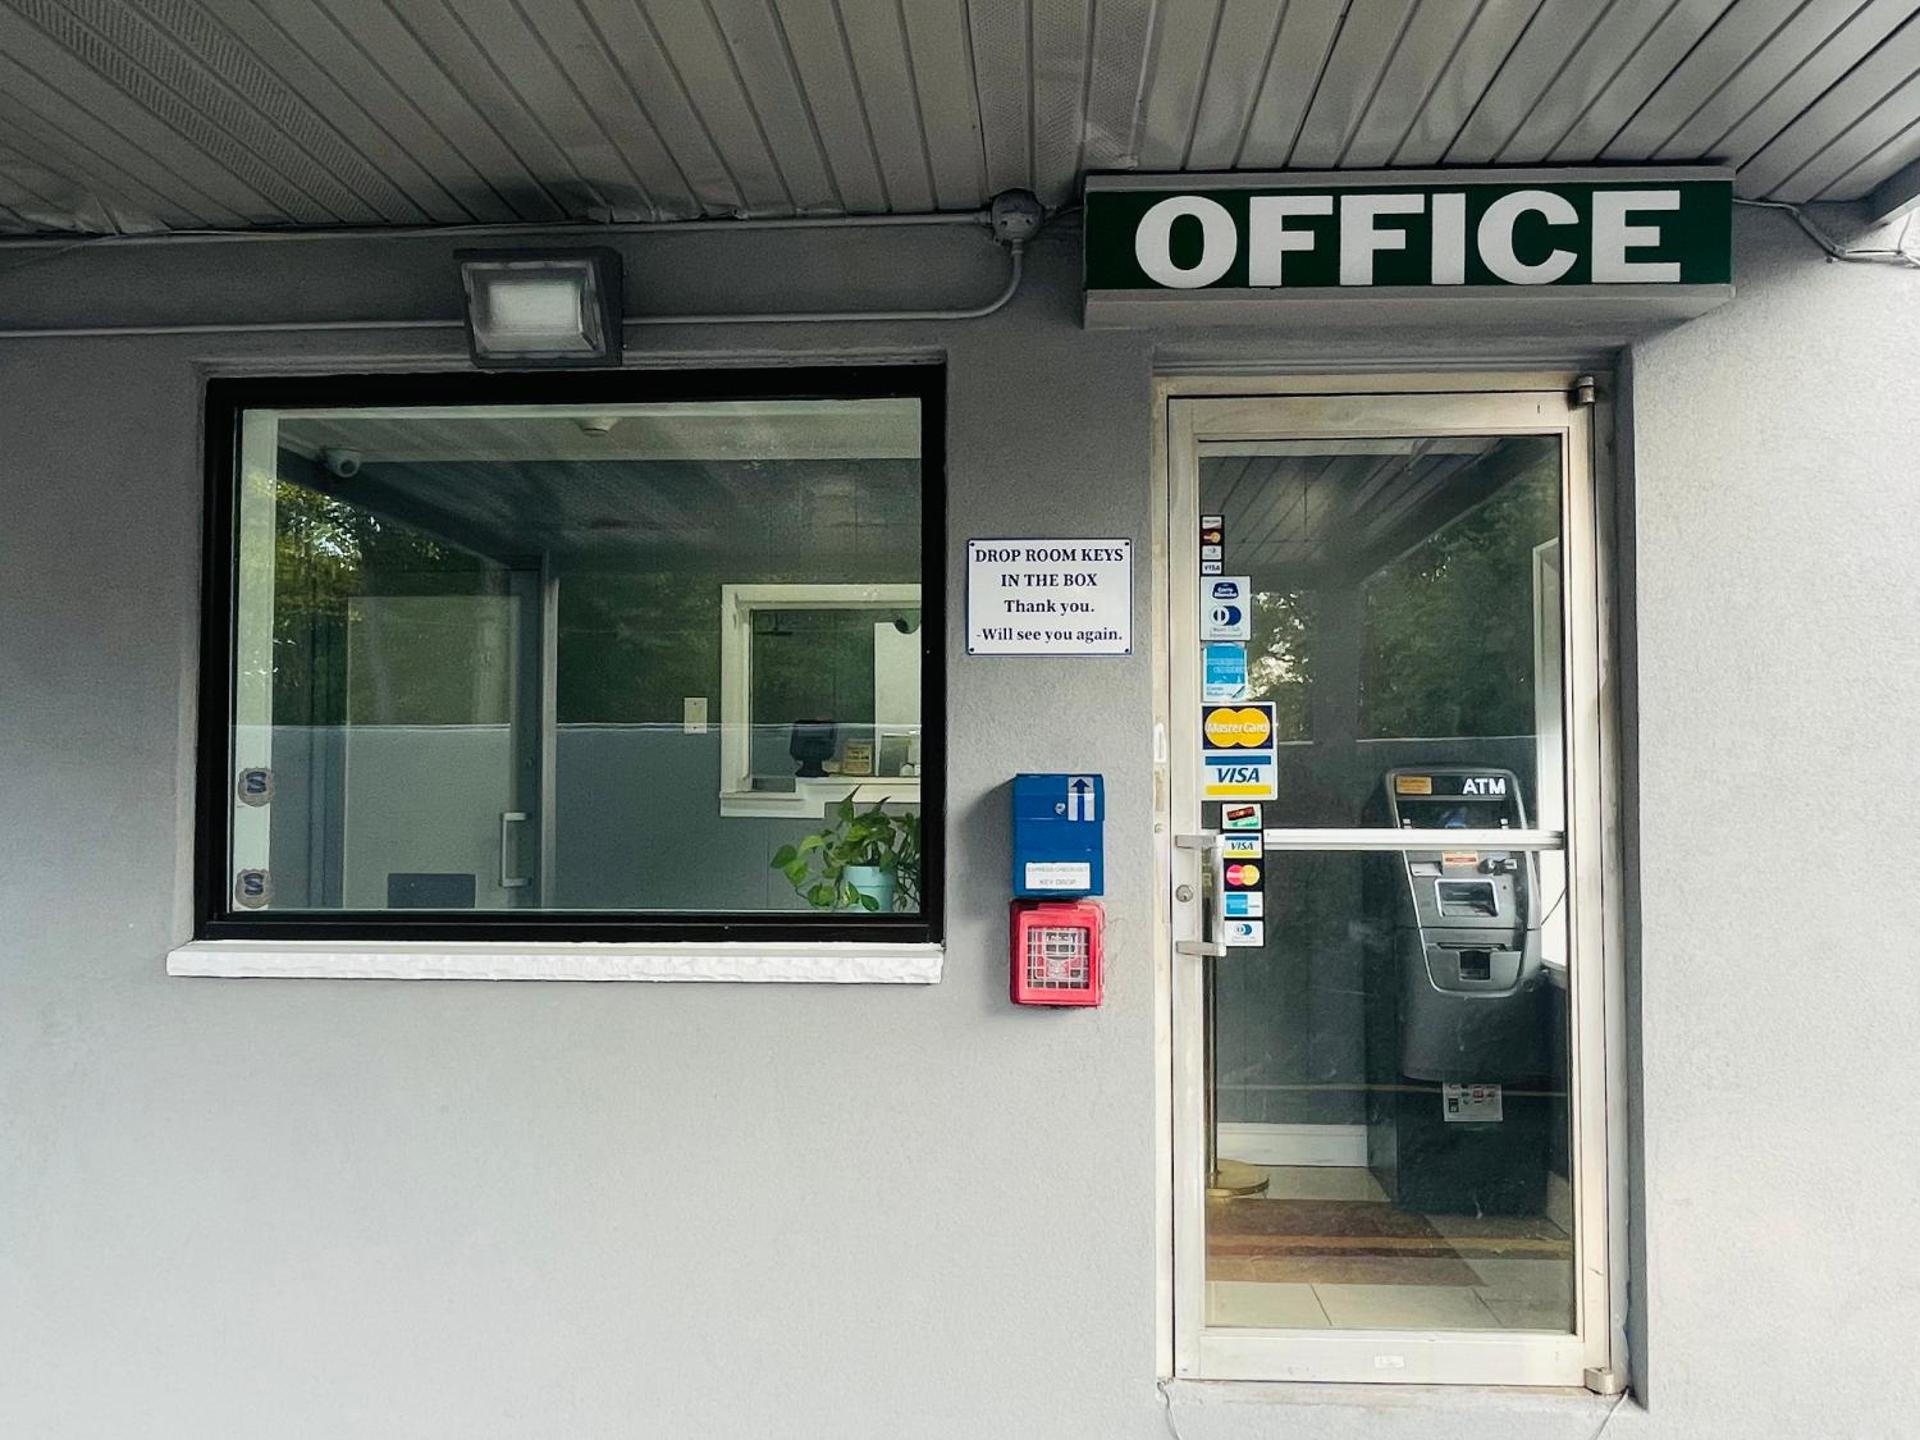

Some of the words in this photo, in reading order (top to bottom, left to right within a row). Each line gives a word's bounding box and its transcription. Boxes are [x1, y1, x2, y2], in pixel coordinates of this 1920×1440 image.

[1134, 190, 1682, 290] OFFICE
[975, 549, 1021, 562] DROP
[1026, 548, 1076, 562] ROOM
[1081, 548, 1124, 562] KEYS
[1001, 574, 1019, 587] IN
[1024, 574, 1059, 587] THE
[1064, 573, 1098, 587] BOX
[1004, 599, 1056, 613] Thank
[1060, 602, 1095, 616] you.
[1016, 630, 1041, 641] see
[1044, 630, 1073, 644] you
[1076, 627, 1123, 644] again.
[1217, 767, 1260, 783] VISA
[1462, 777, 1506, 795] ATM
[1231, 841, 1254, 850] VISA
